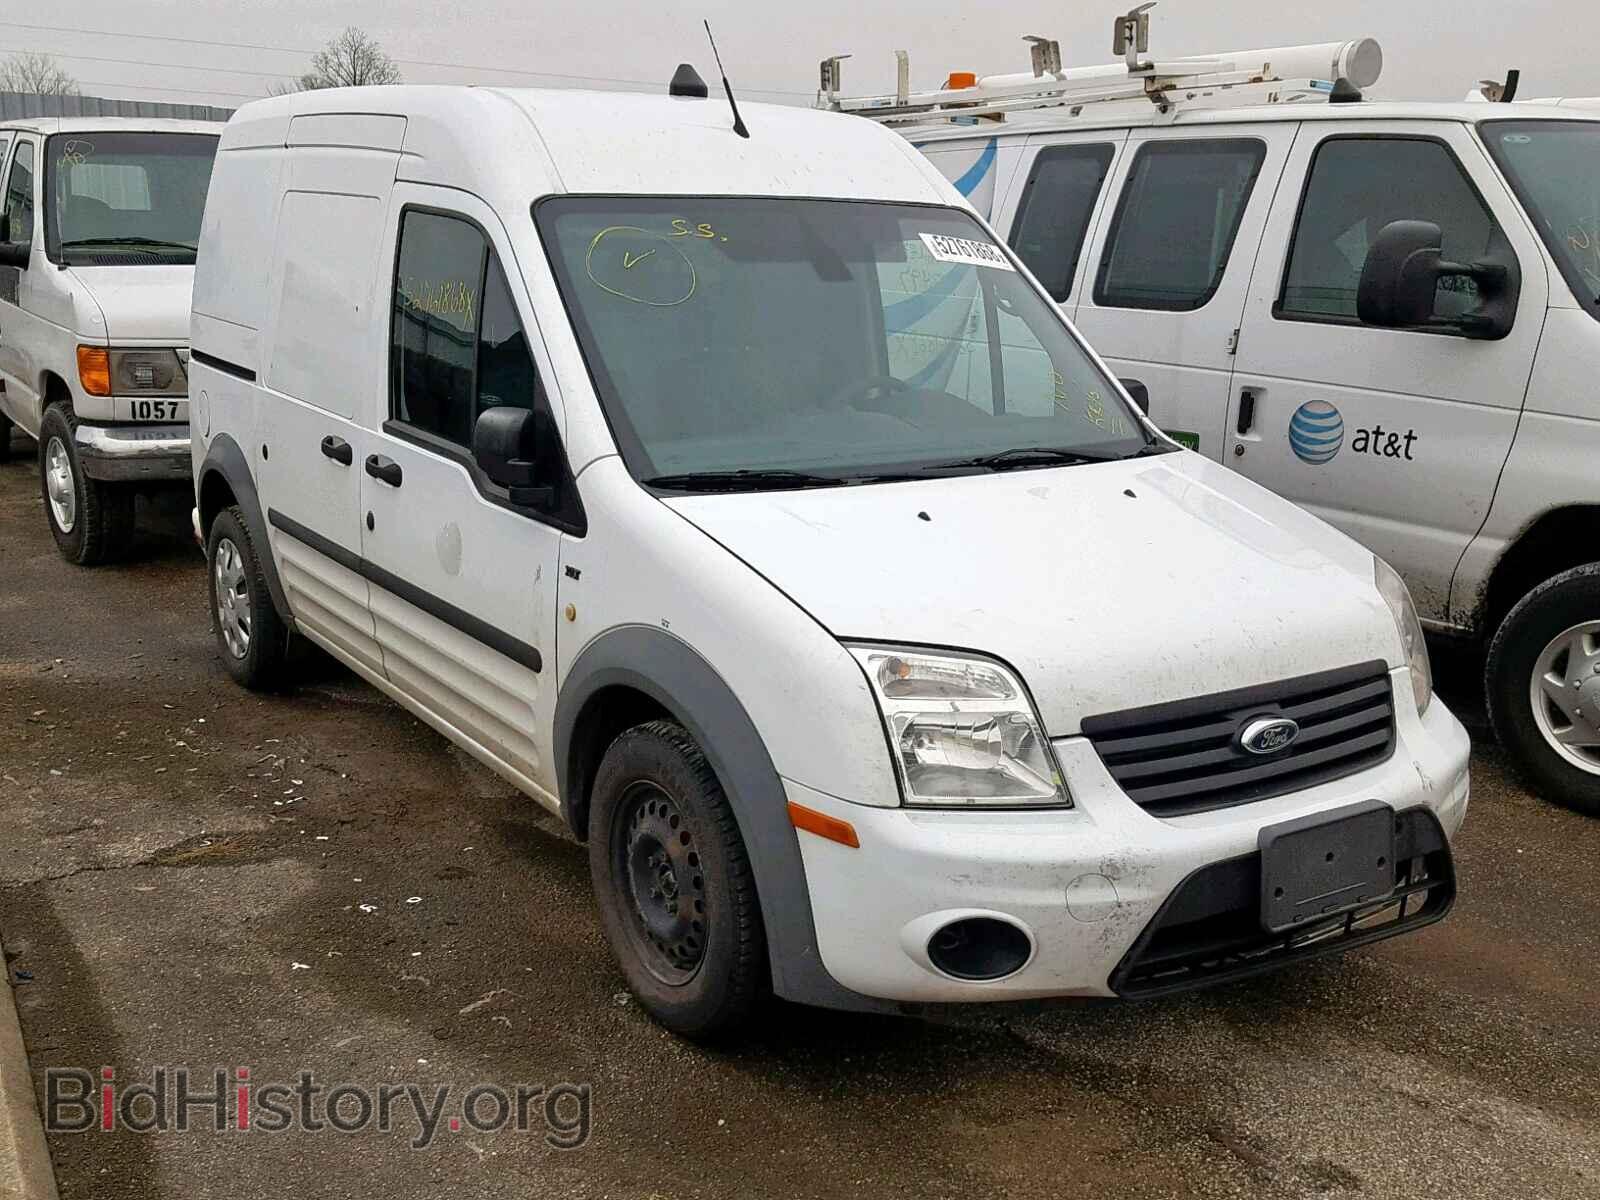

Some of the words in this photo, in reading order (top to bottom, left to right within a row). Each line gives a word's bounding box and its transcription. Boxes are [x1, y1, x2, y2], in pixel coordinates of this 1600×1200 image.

[932, 235, 1001, 262] 52761868
[130, 401, 178, 420] 1057
[1352, 425, 1418, 460] at&t
